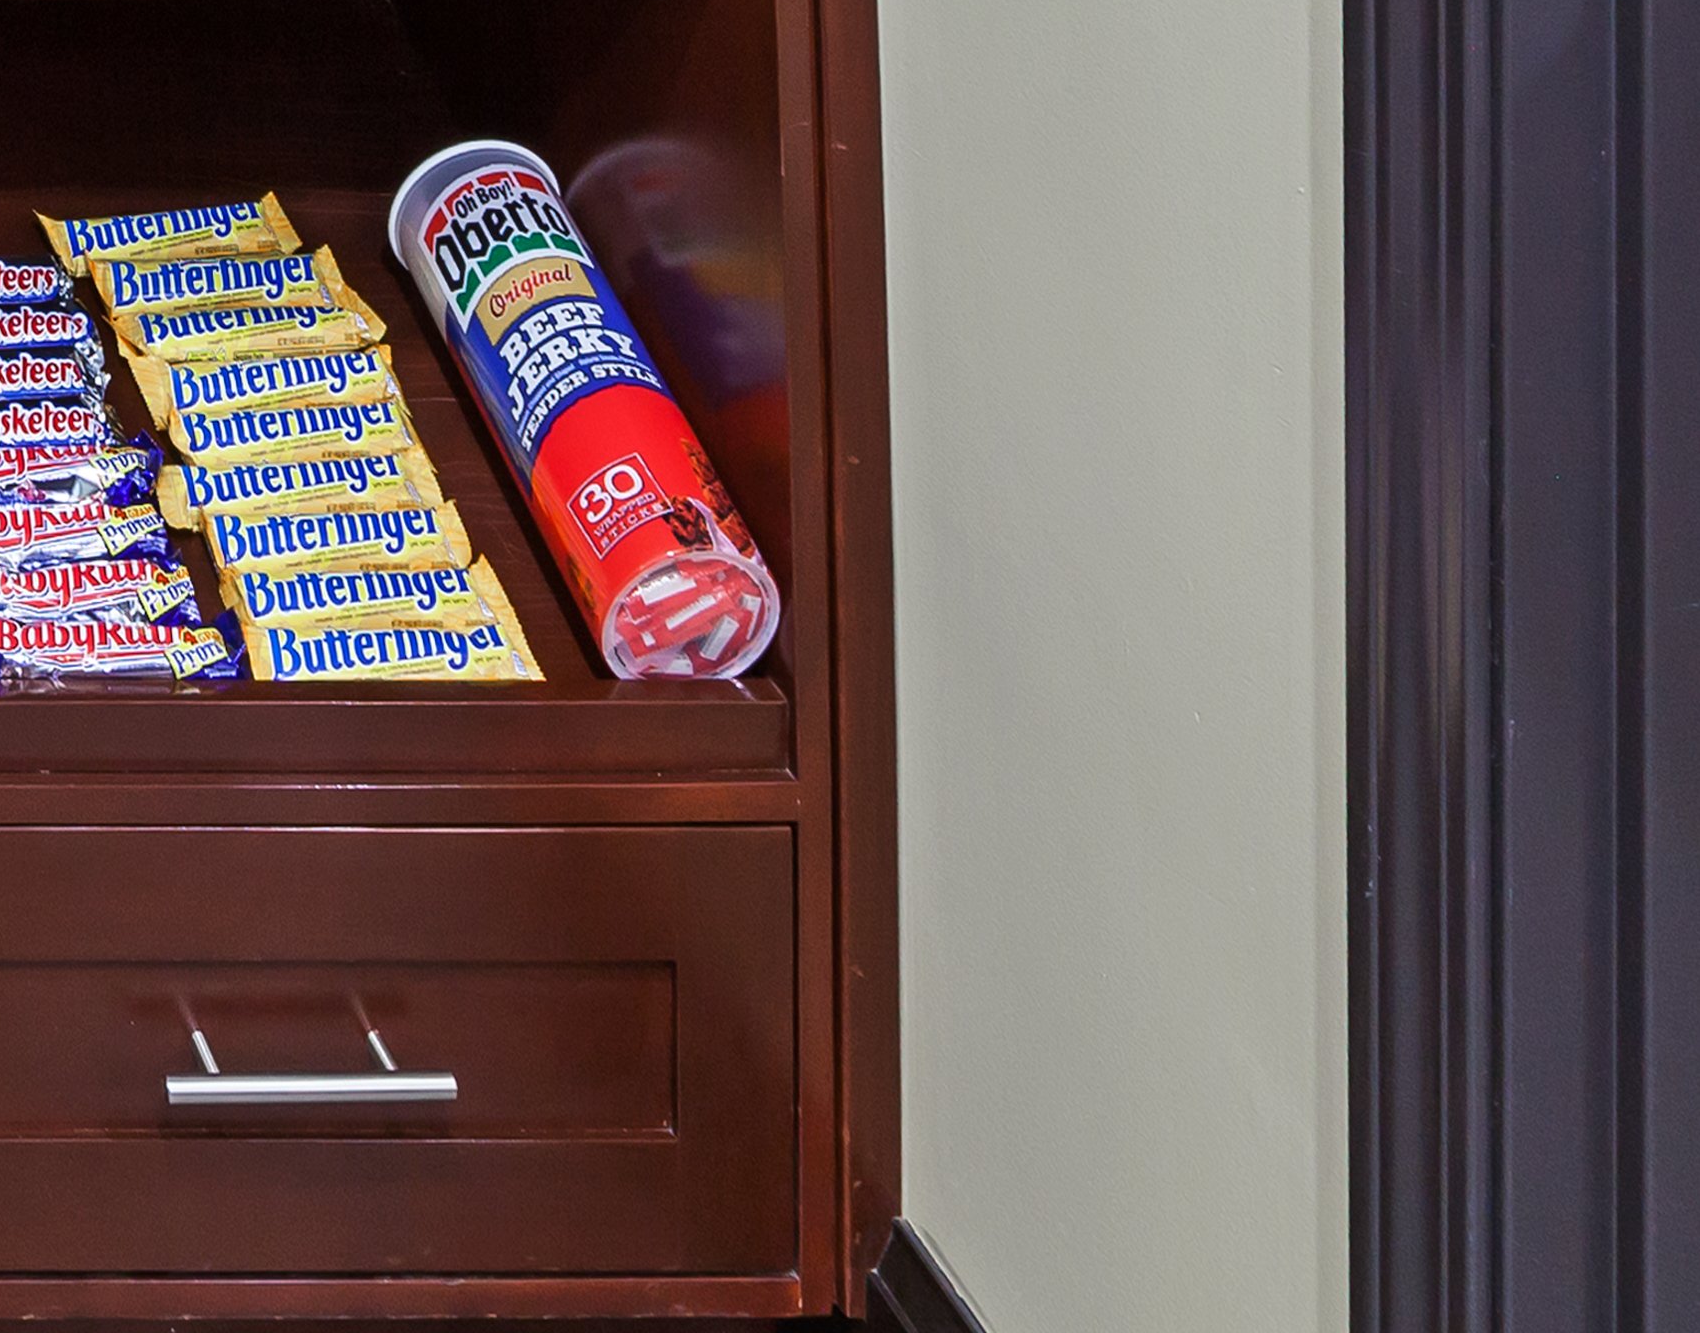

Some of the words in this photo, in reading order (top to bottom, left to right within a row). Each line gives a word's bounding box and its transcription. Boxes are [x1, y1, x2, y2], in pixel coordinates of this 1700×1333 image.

[455, 191, 477, 218] Oh
[476, 180, 513, 210] Boy!
[432, 191, 569, 293] Oberto
[111, 252, 316, 309] Butterfinger
[489, 263, 574, 319] Original
[499, 301, 605, 376] BEEF
[509, 332, 639, 423] JERKY
[519, 367, 590, 452] TENDER
[592, 363, 665, 391] STYLE
[578, 460, 644, 525] 30
[594, 492, 655, 539] WRAPPED
[599, 503, 666, 549] STICKS
[268, 624, 505, 682] Butterfinger
